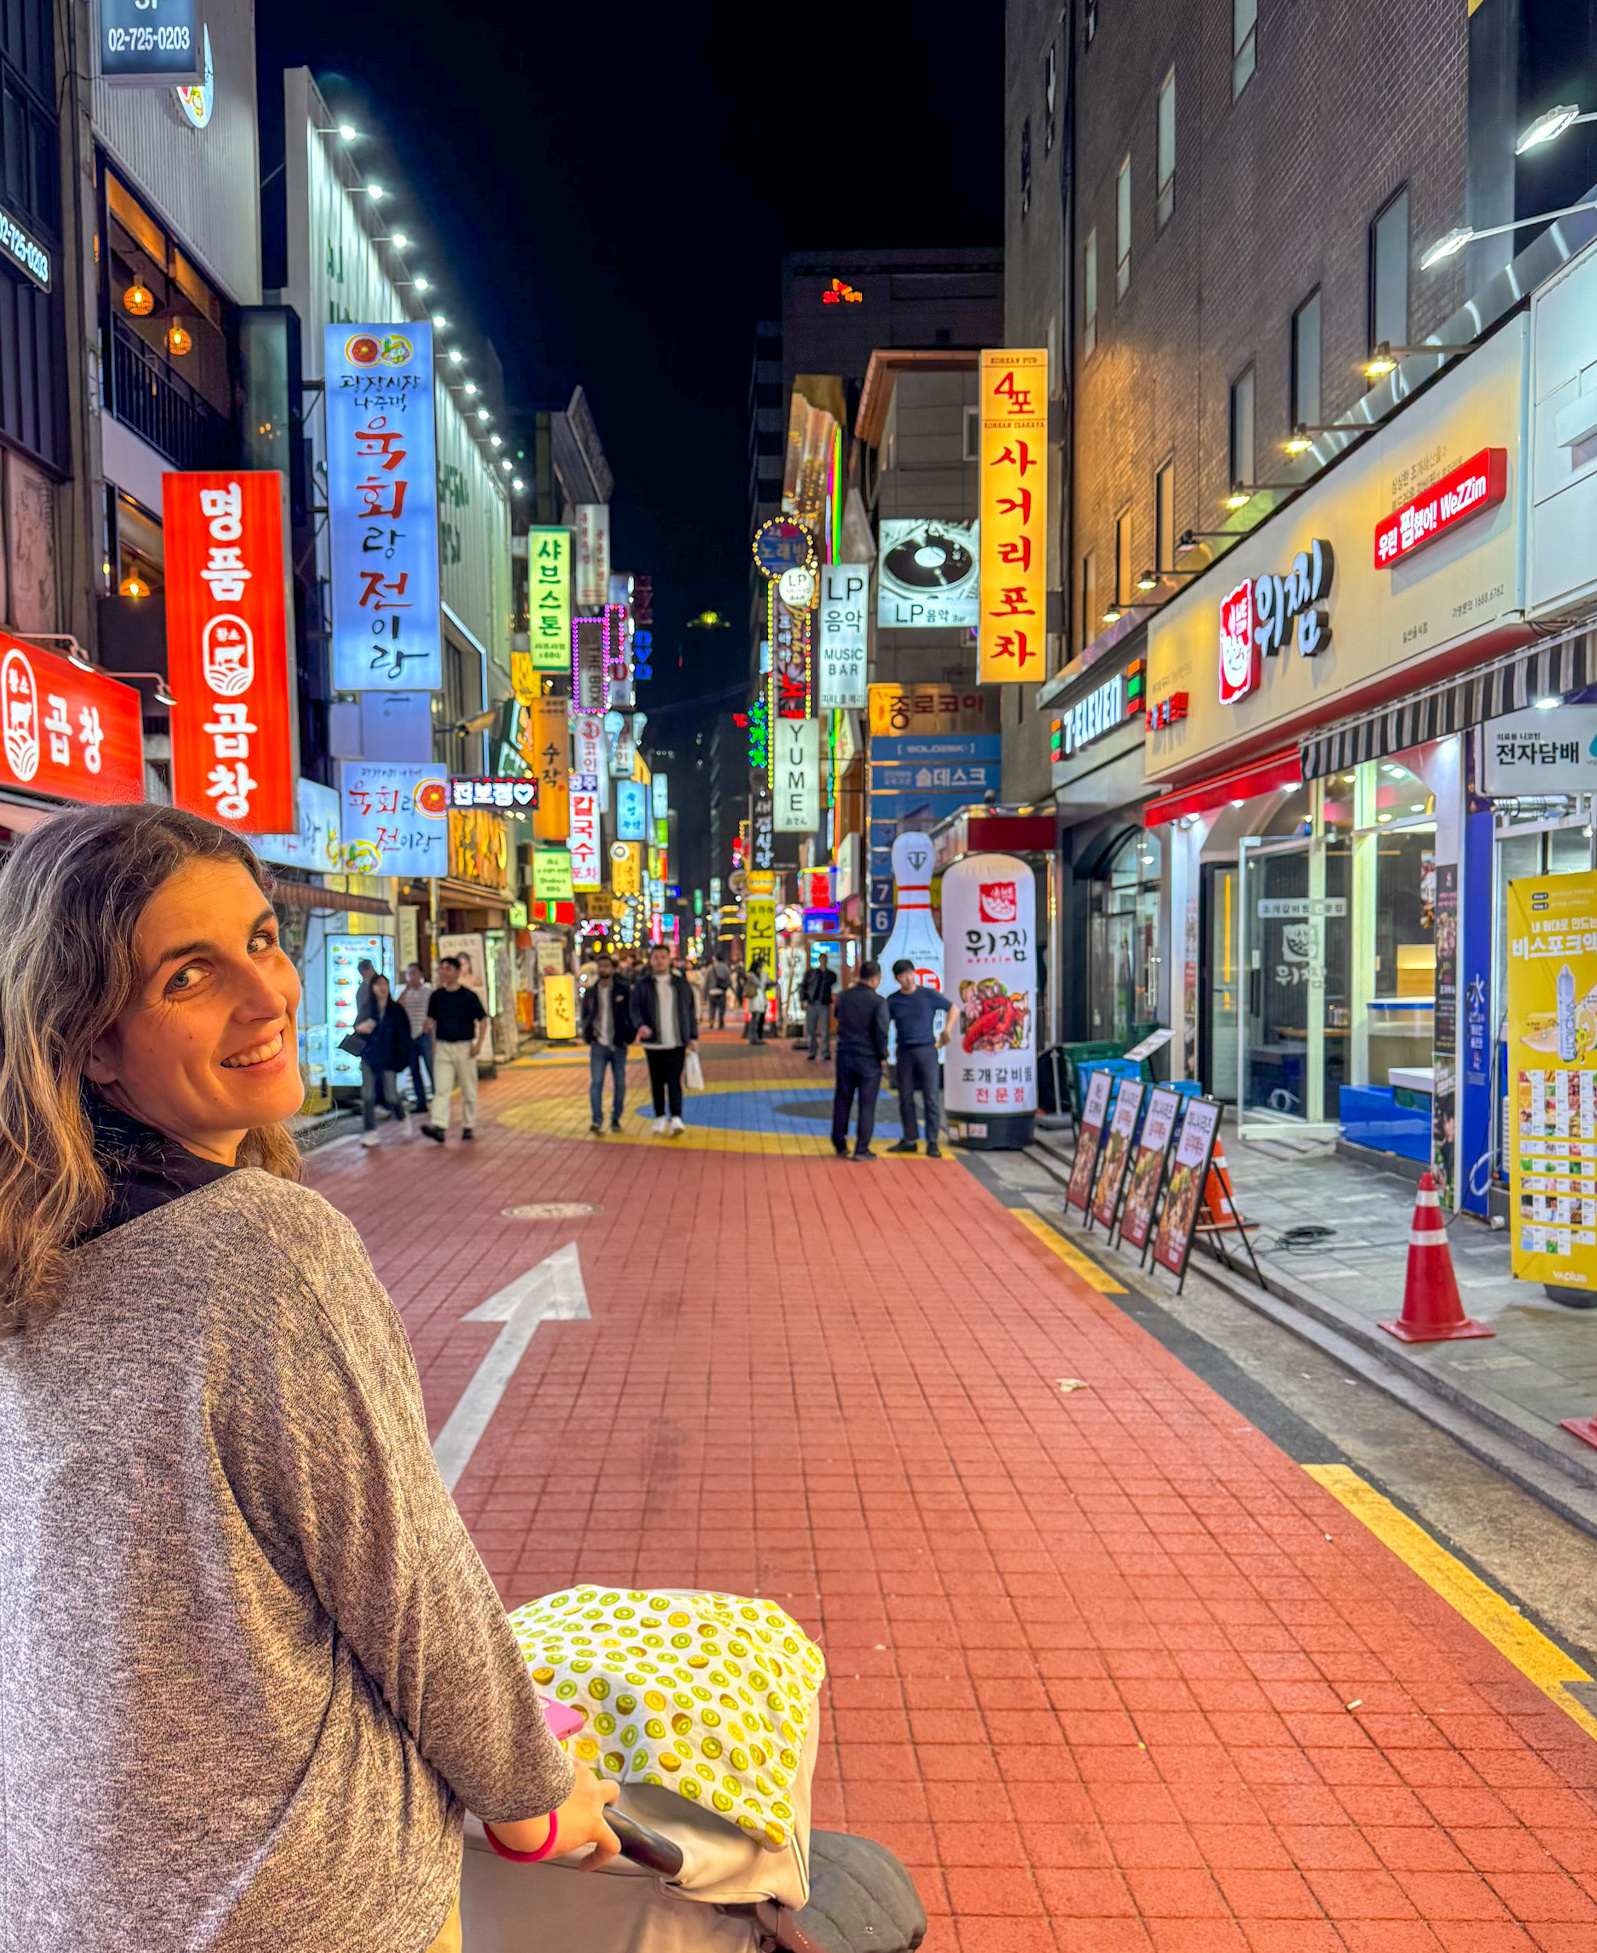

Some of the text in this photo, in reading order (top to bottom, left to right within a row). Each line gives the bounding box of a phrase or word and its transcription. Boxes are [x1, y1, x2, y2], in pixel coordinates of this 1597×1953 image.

[108, 26, 190, 51] 02-725-0203
[339, 374, 421, 393] 광장시장
[994, 371, 1034, 414] 4포
[354, 415, 410, 560] 육회랑
[1378, 527, 1398, 561] 우린
[1440, 475, 1486, 521] WeZZim
[200, 482, 252, 602] 명품
[990, 439, 1037, 668] 사거리포차
[538, 539, 562, 637] 샤브스톤
[788, 574, 807, 587] LP
[828, 577, 863, 600] LP
[896, 604, 924, 623] LP
[926, 609, 949, 623] 음악
[1254, 538, 1324, 658] 위찜
[358, 570, 429, 680] 전이랑
[825, 610, 863, 633] 음악
[634, 630, 653, 681] DVD
[824, 649, 863, 661] MUSIC
[828, 664, 858, 676] BAR
[44, 693, 104, 775] 곱창
[203, 702, 258, 819] 곱창
[788, 724, 806, 811] YUME
[1496, 741, 1580, 766] 전자담배
[376, 826, 442, 853] 전이랑
[572, 796, 594, 863] 칼국수
[877, 884, 889, 900] 7
[875, 912, 888, 930] 6
[966, 929, 1027, 962] 위찜
[976, 1087, 1025, 1104] 전문점
